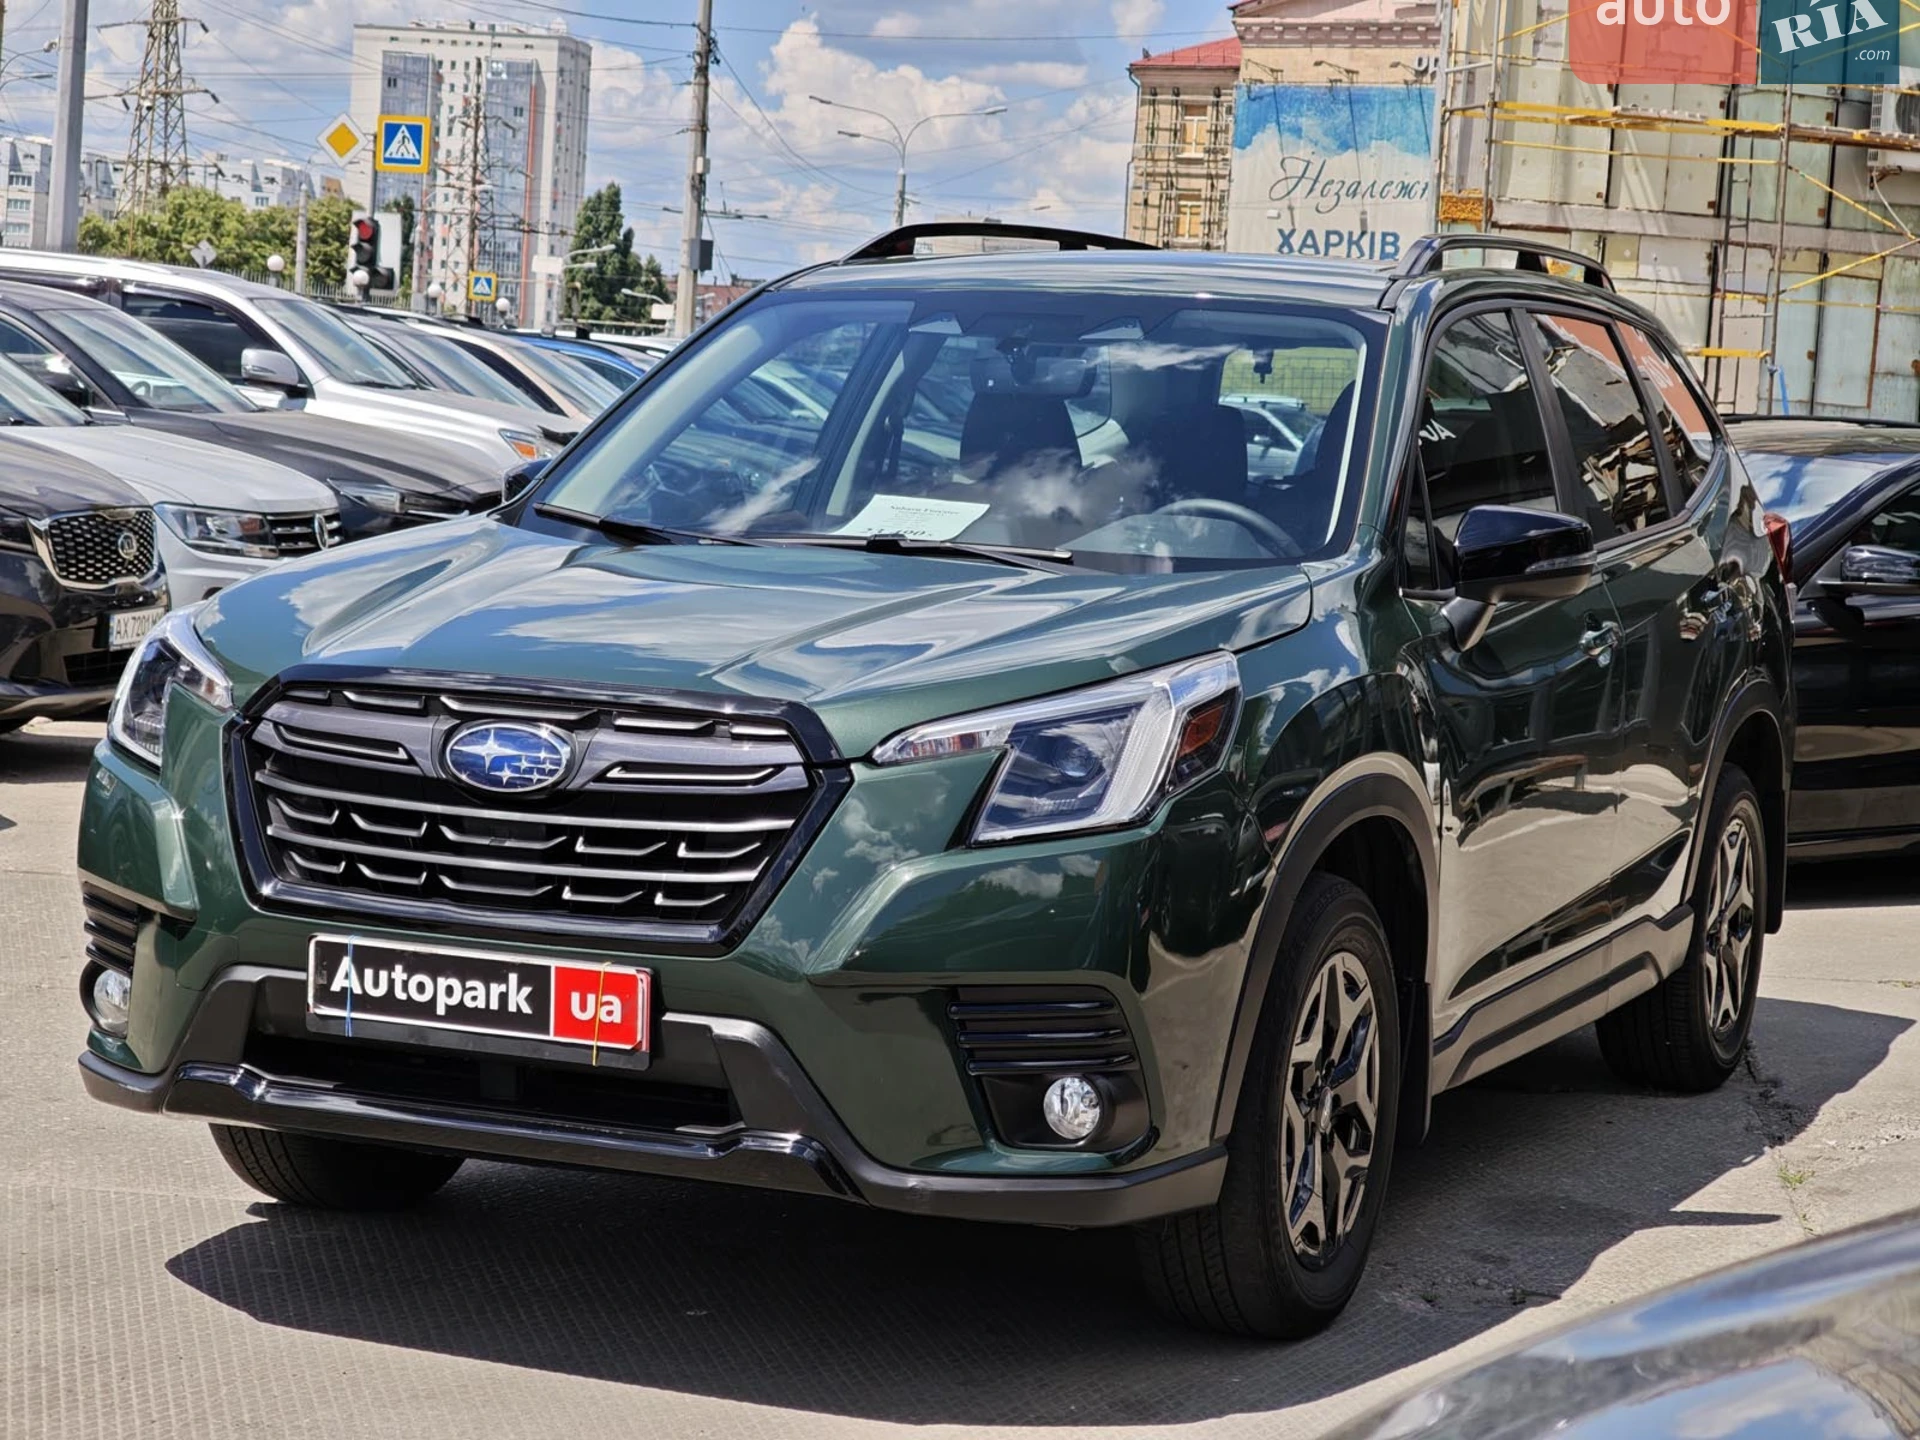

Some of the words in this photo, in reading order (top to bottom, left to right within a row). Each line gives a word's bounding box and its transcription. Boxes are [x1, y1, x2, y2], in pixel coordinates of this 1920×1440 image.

[1277, 227, 1400, 261] ХАРКІВ
[115, 617, 130, 640] AX
[330, 956, 533, 1016] Autopark
[570, 991, 622, 1024] ua
